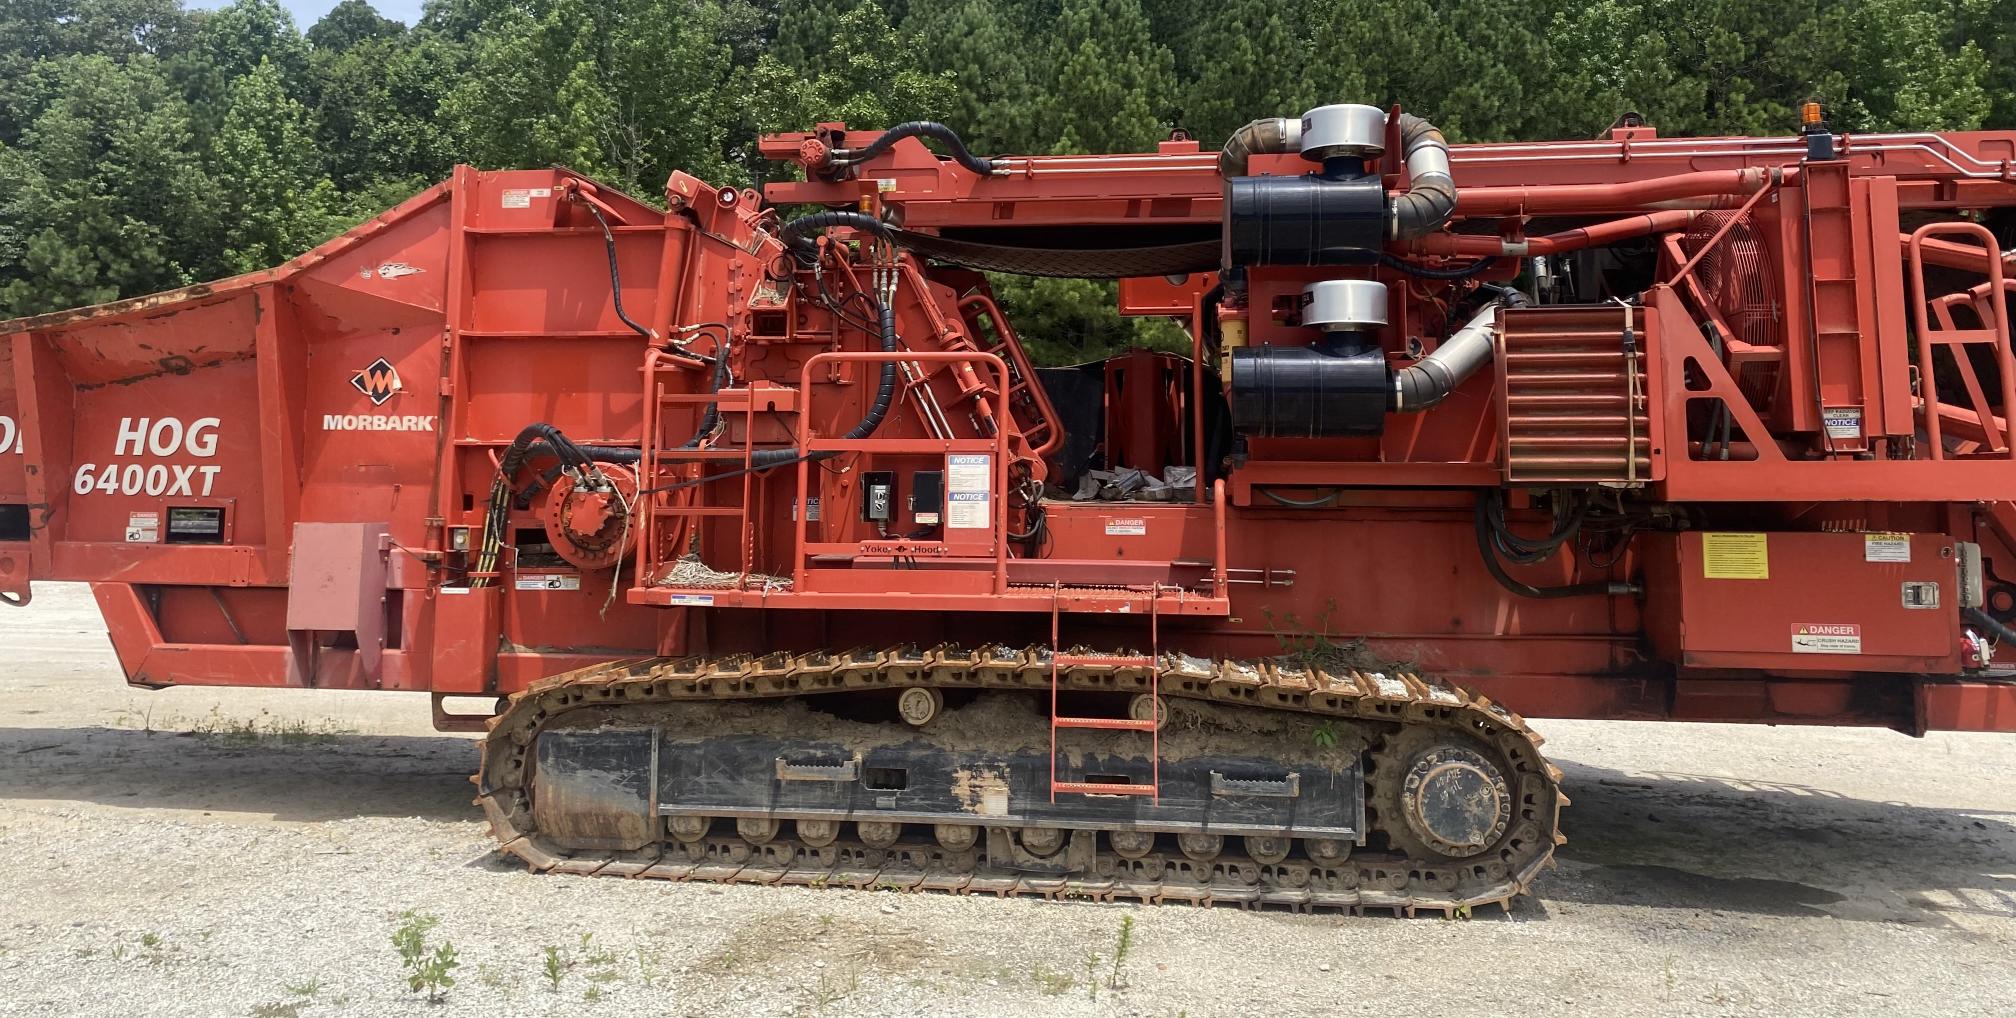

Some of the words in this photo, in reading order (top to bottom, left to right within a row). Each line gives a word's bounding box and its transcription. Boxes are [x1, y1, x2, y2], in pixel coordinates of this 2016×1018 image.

[323, 414, 434, 431] MORBARK
[114, 417, 221, 457] HOG
[953, 457, 985, 465] NOTICE
[74, 463, 222, 497] 6400XT
[953, 493, 984, 501] NOTICE
[865, 545, 888, 553] Yoke
[914, 545, 939, 553] Hood
[1809, 625, 1854, 635] DANGER
